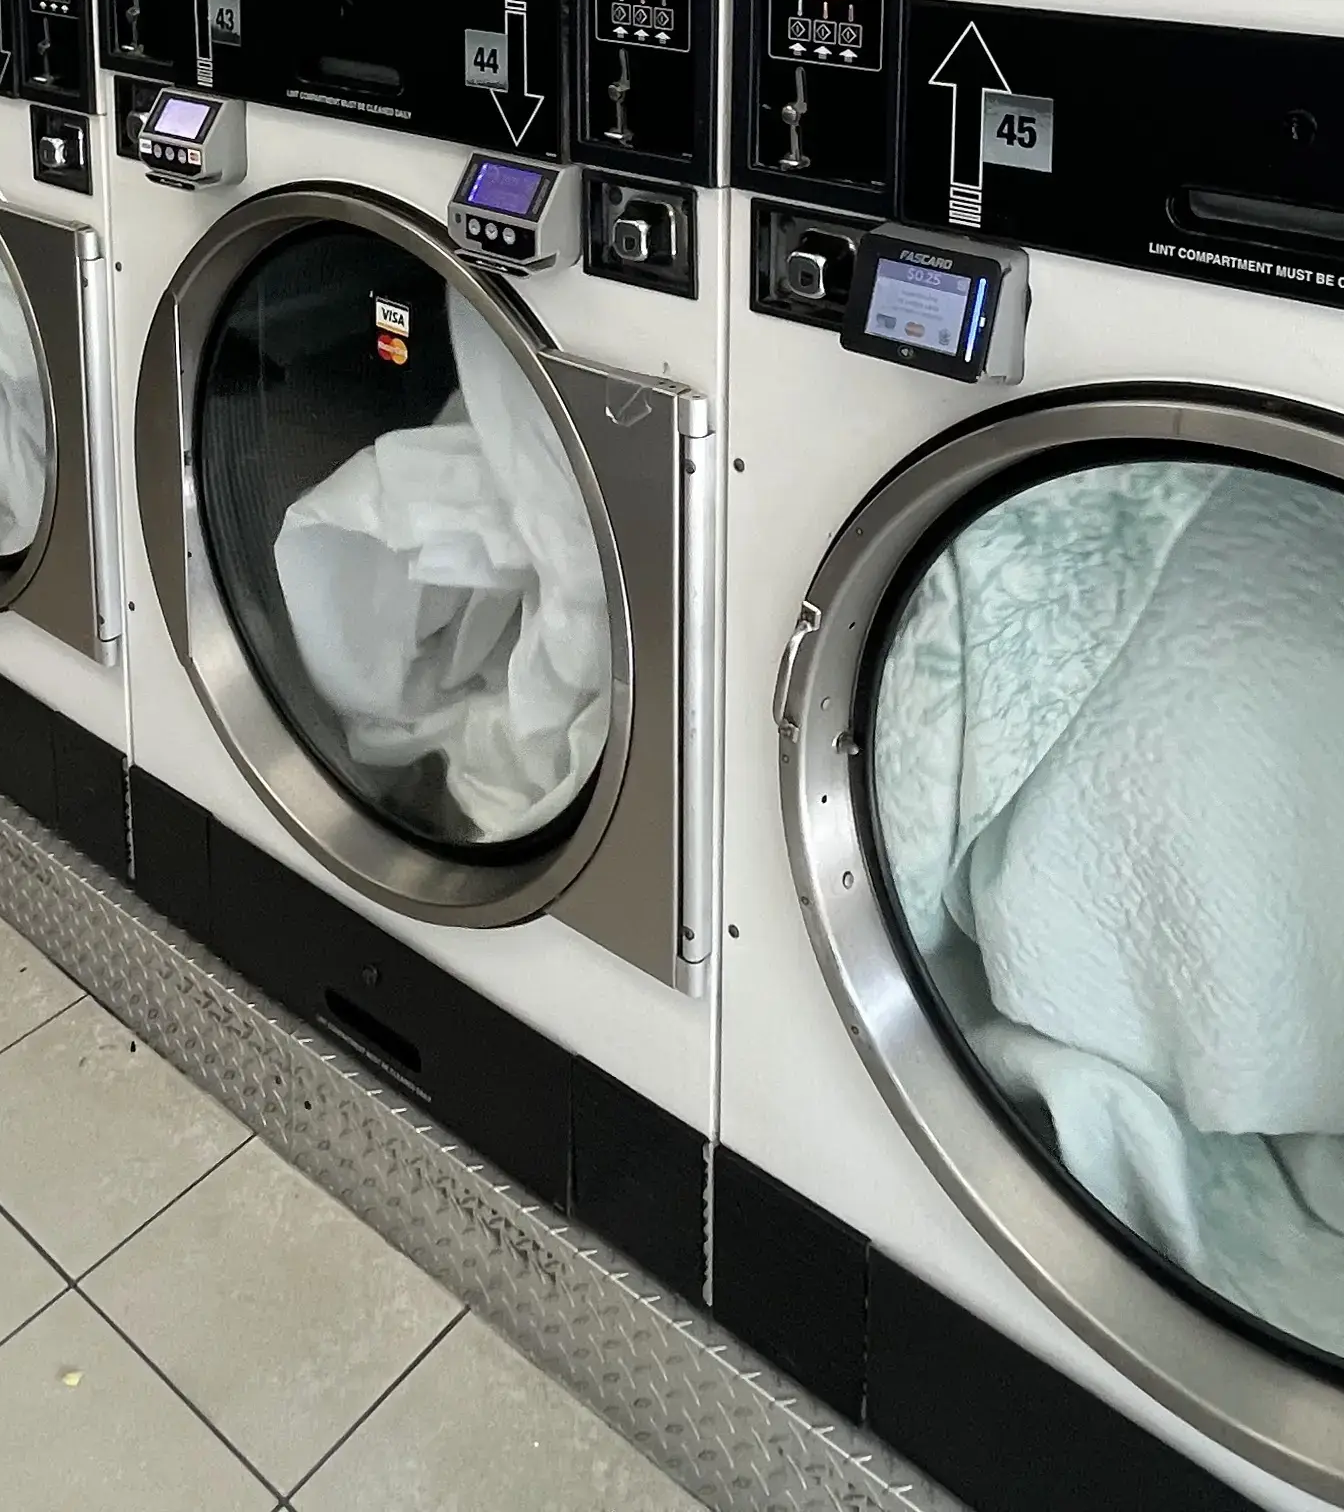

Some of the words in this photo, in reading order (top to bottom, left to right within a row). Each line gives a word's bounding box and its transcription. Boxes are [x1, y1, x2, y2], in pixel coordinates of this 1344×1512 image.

[215, 8, 235, 32] 43
[473, 46, 499, 74] 44
[996, 113, 1037, 149] 45
[900, 250, 953, 269] FASCARD
[1149, 242, 1176, 257] LINT
[1178, 247, 1273, 274] COMPARTMENT
[1276, 265, 1313, 282] MUST
[1316, 272, 1335, 286] BE
[382, 306, 405, 327] VISA
